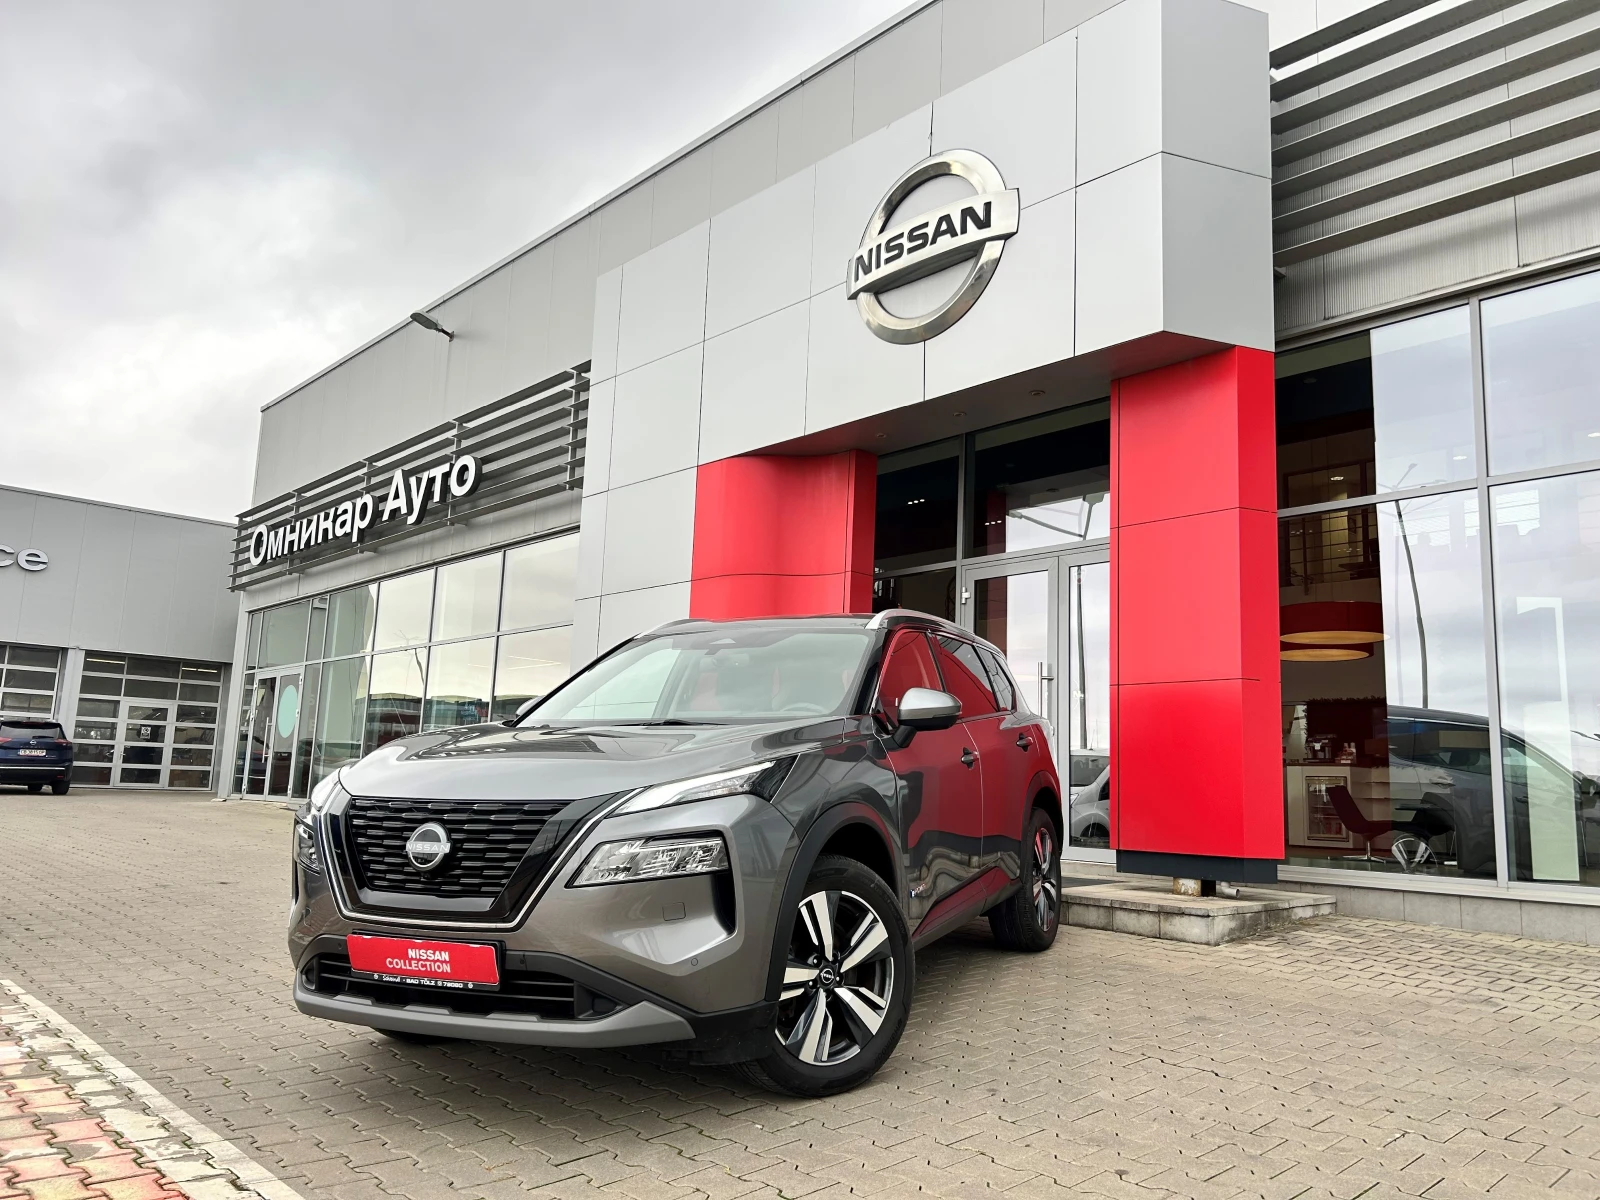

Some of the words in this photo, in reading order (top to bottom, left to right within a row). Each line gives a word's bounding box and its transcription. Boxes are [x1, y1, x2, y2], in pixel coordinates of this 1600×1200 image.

[854, 201, 992, 283] NISSAN
[249, 493, 374, 566] Омникар
[382, 454, 477, 525] Ауто
[407, 843, 449, 852] NISSAN
[407, 948, 449, 961] NISSAN
[386, 957, 451, 973] COLLECTION
